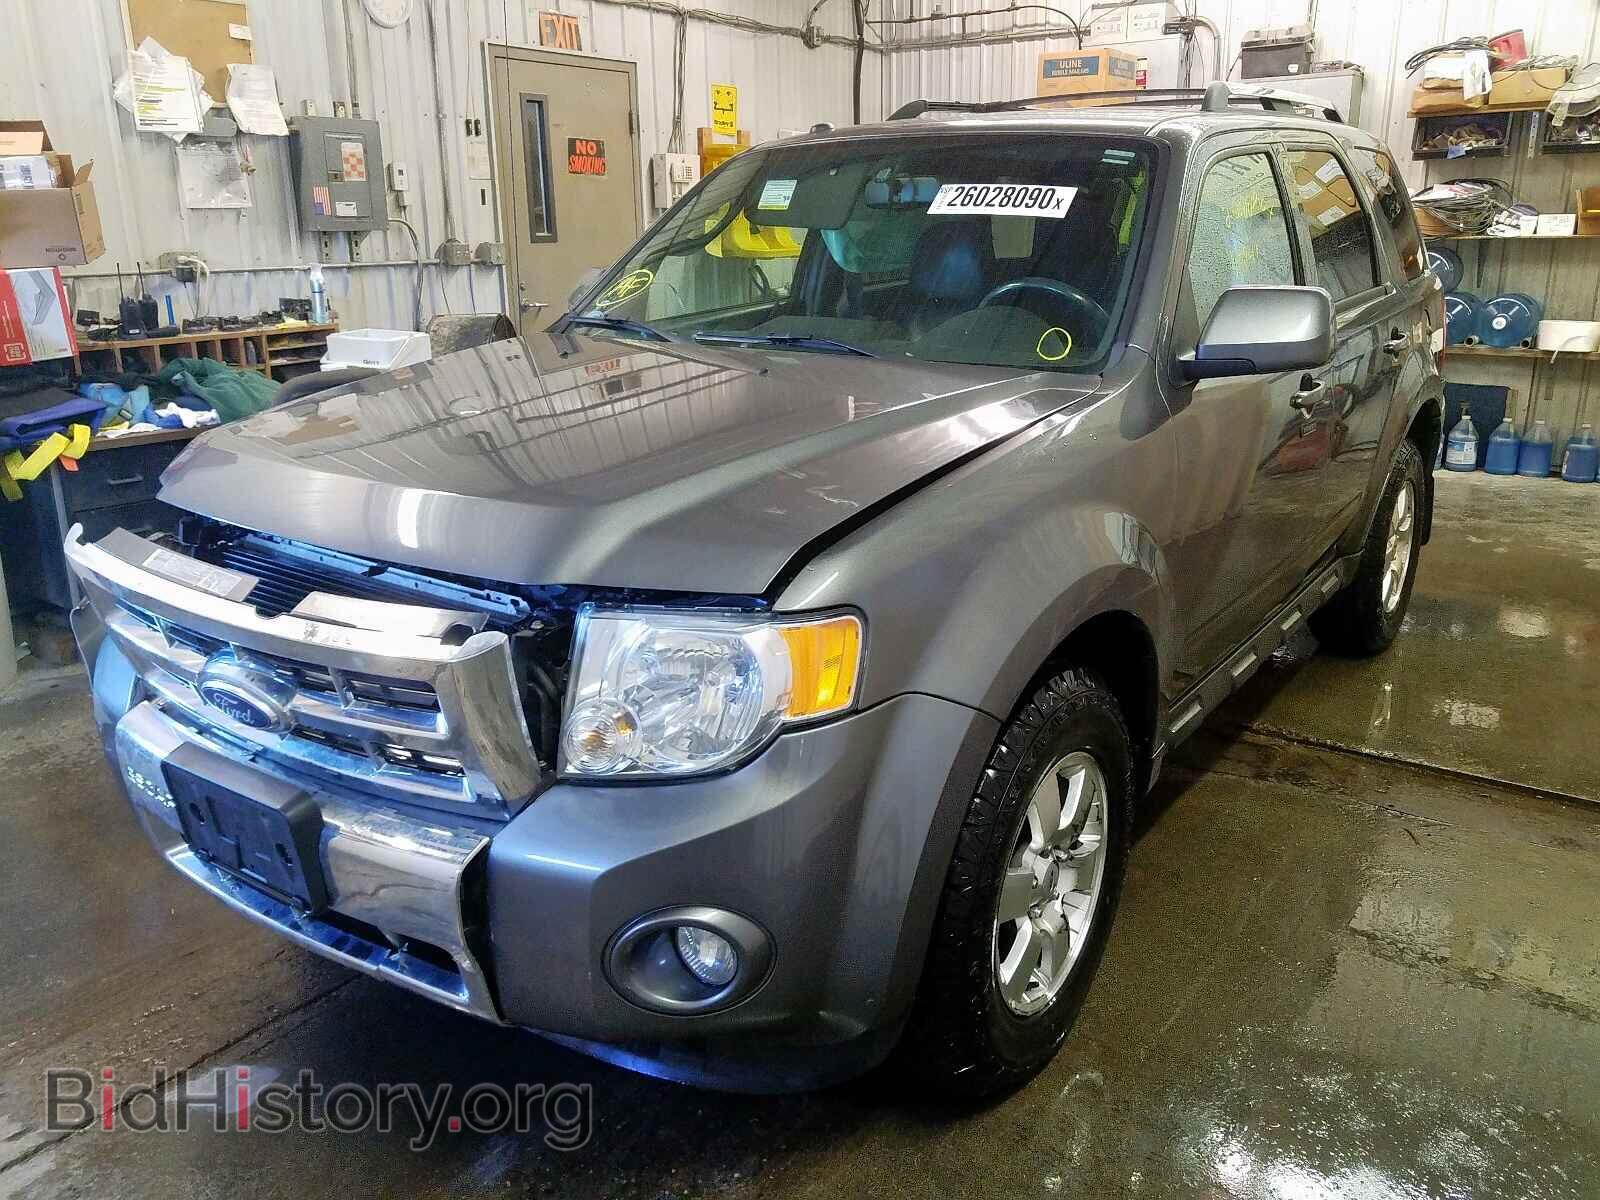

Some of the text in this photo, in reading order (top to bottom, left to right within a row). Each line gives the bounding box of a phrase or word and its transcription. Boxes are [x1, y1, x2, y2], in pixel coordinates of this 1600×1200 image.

[540, 14, 578, 49] EXIT
[1059, 59, 1083, 69] ULINE
[575, 139, 597, 155] NO
[569, 154, 607, 175] SMOKING
[213, 692, 253, 723] Ford
